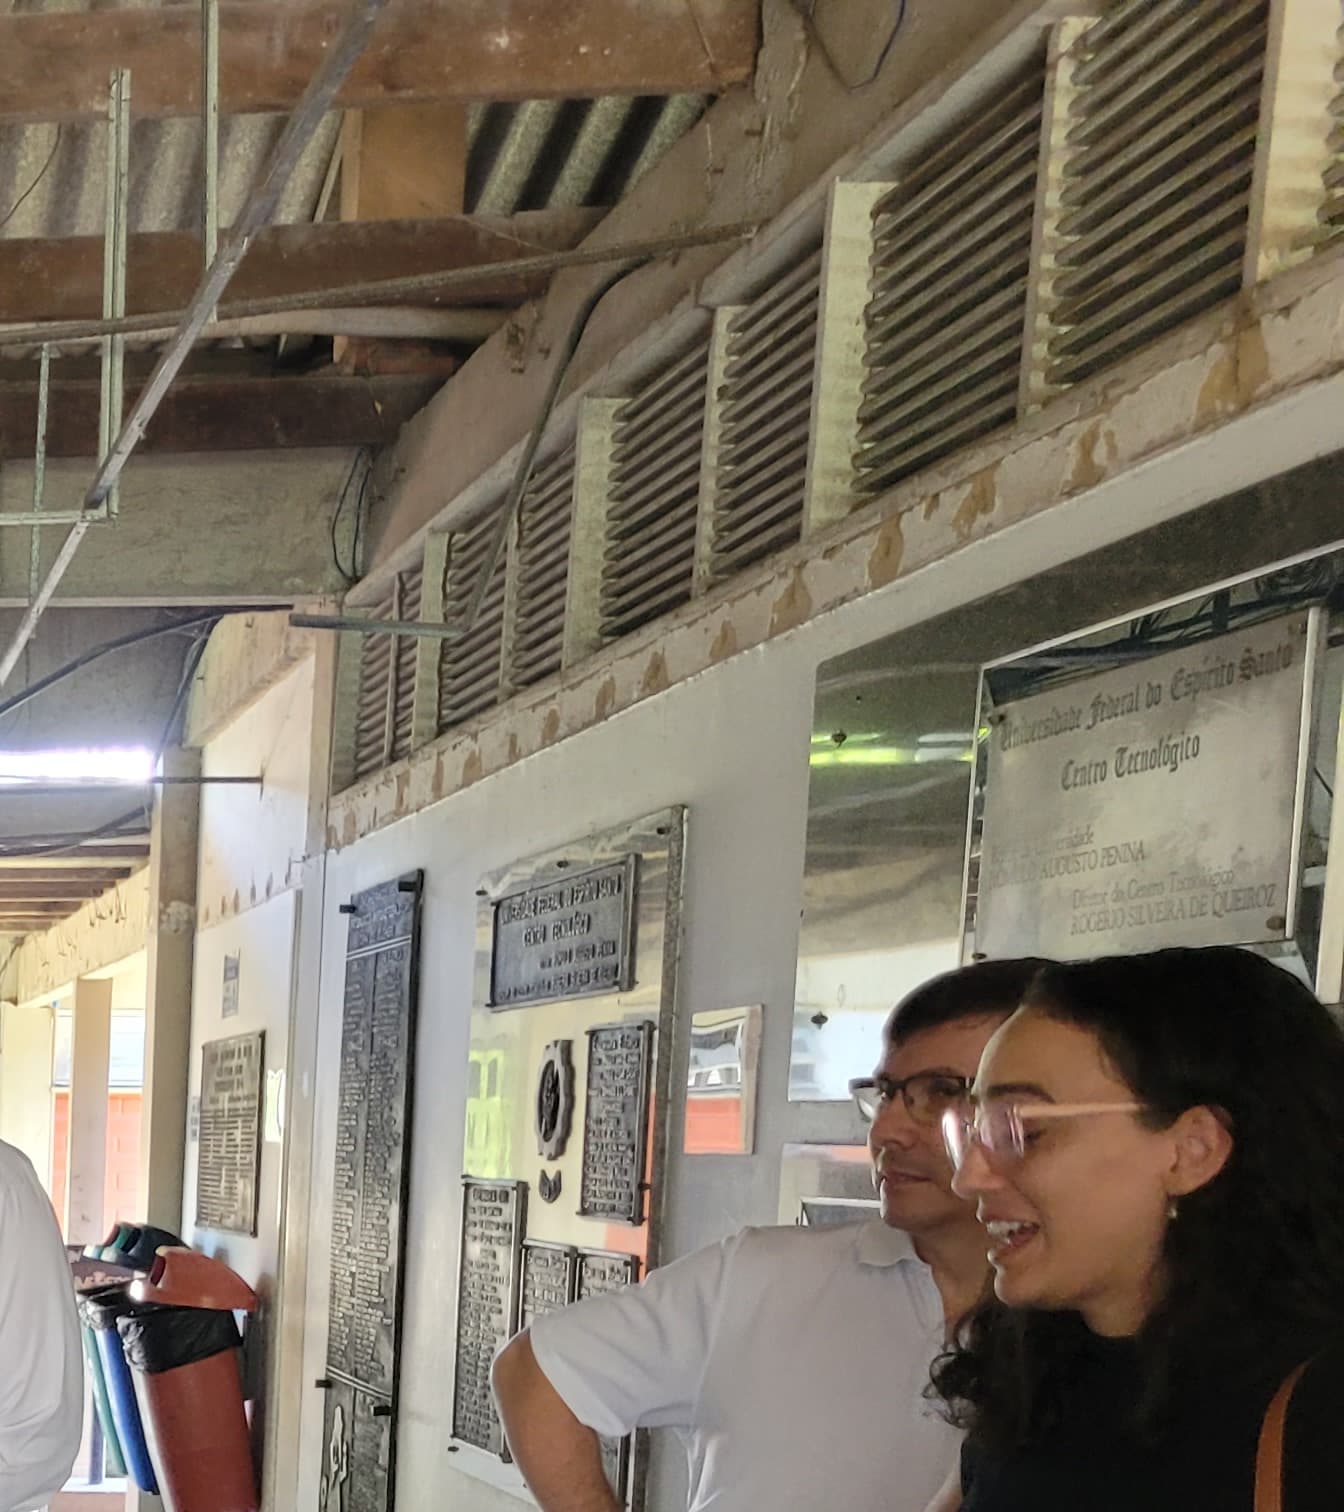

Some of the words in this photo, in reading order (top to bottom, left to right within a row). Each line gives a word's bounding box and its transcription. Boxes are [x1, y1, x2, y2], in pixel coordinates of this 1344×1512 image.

[999, 707, 1083, 752] Universidade
[1086, 684, 1140, 730] Federal
[1144, 681, 1162, 709] do
[1238, 642, 1294, 682] Santo
[1063, 759, 1108, 791] Centro
[1114, 733, 1201, 779] Tecnológico
